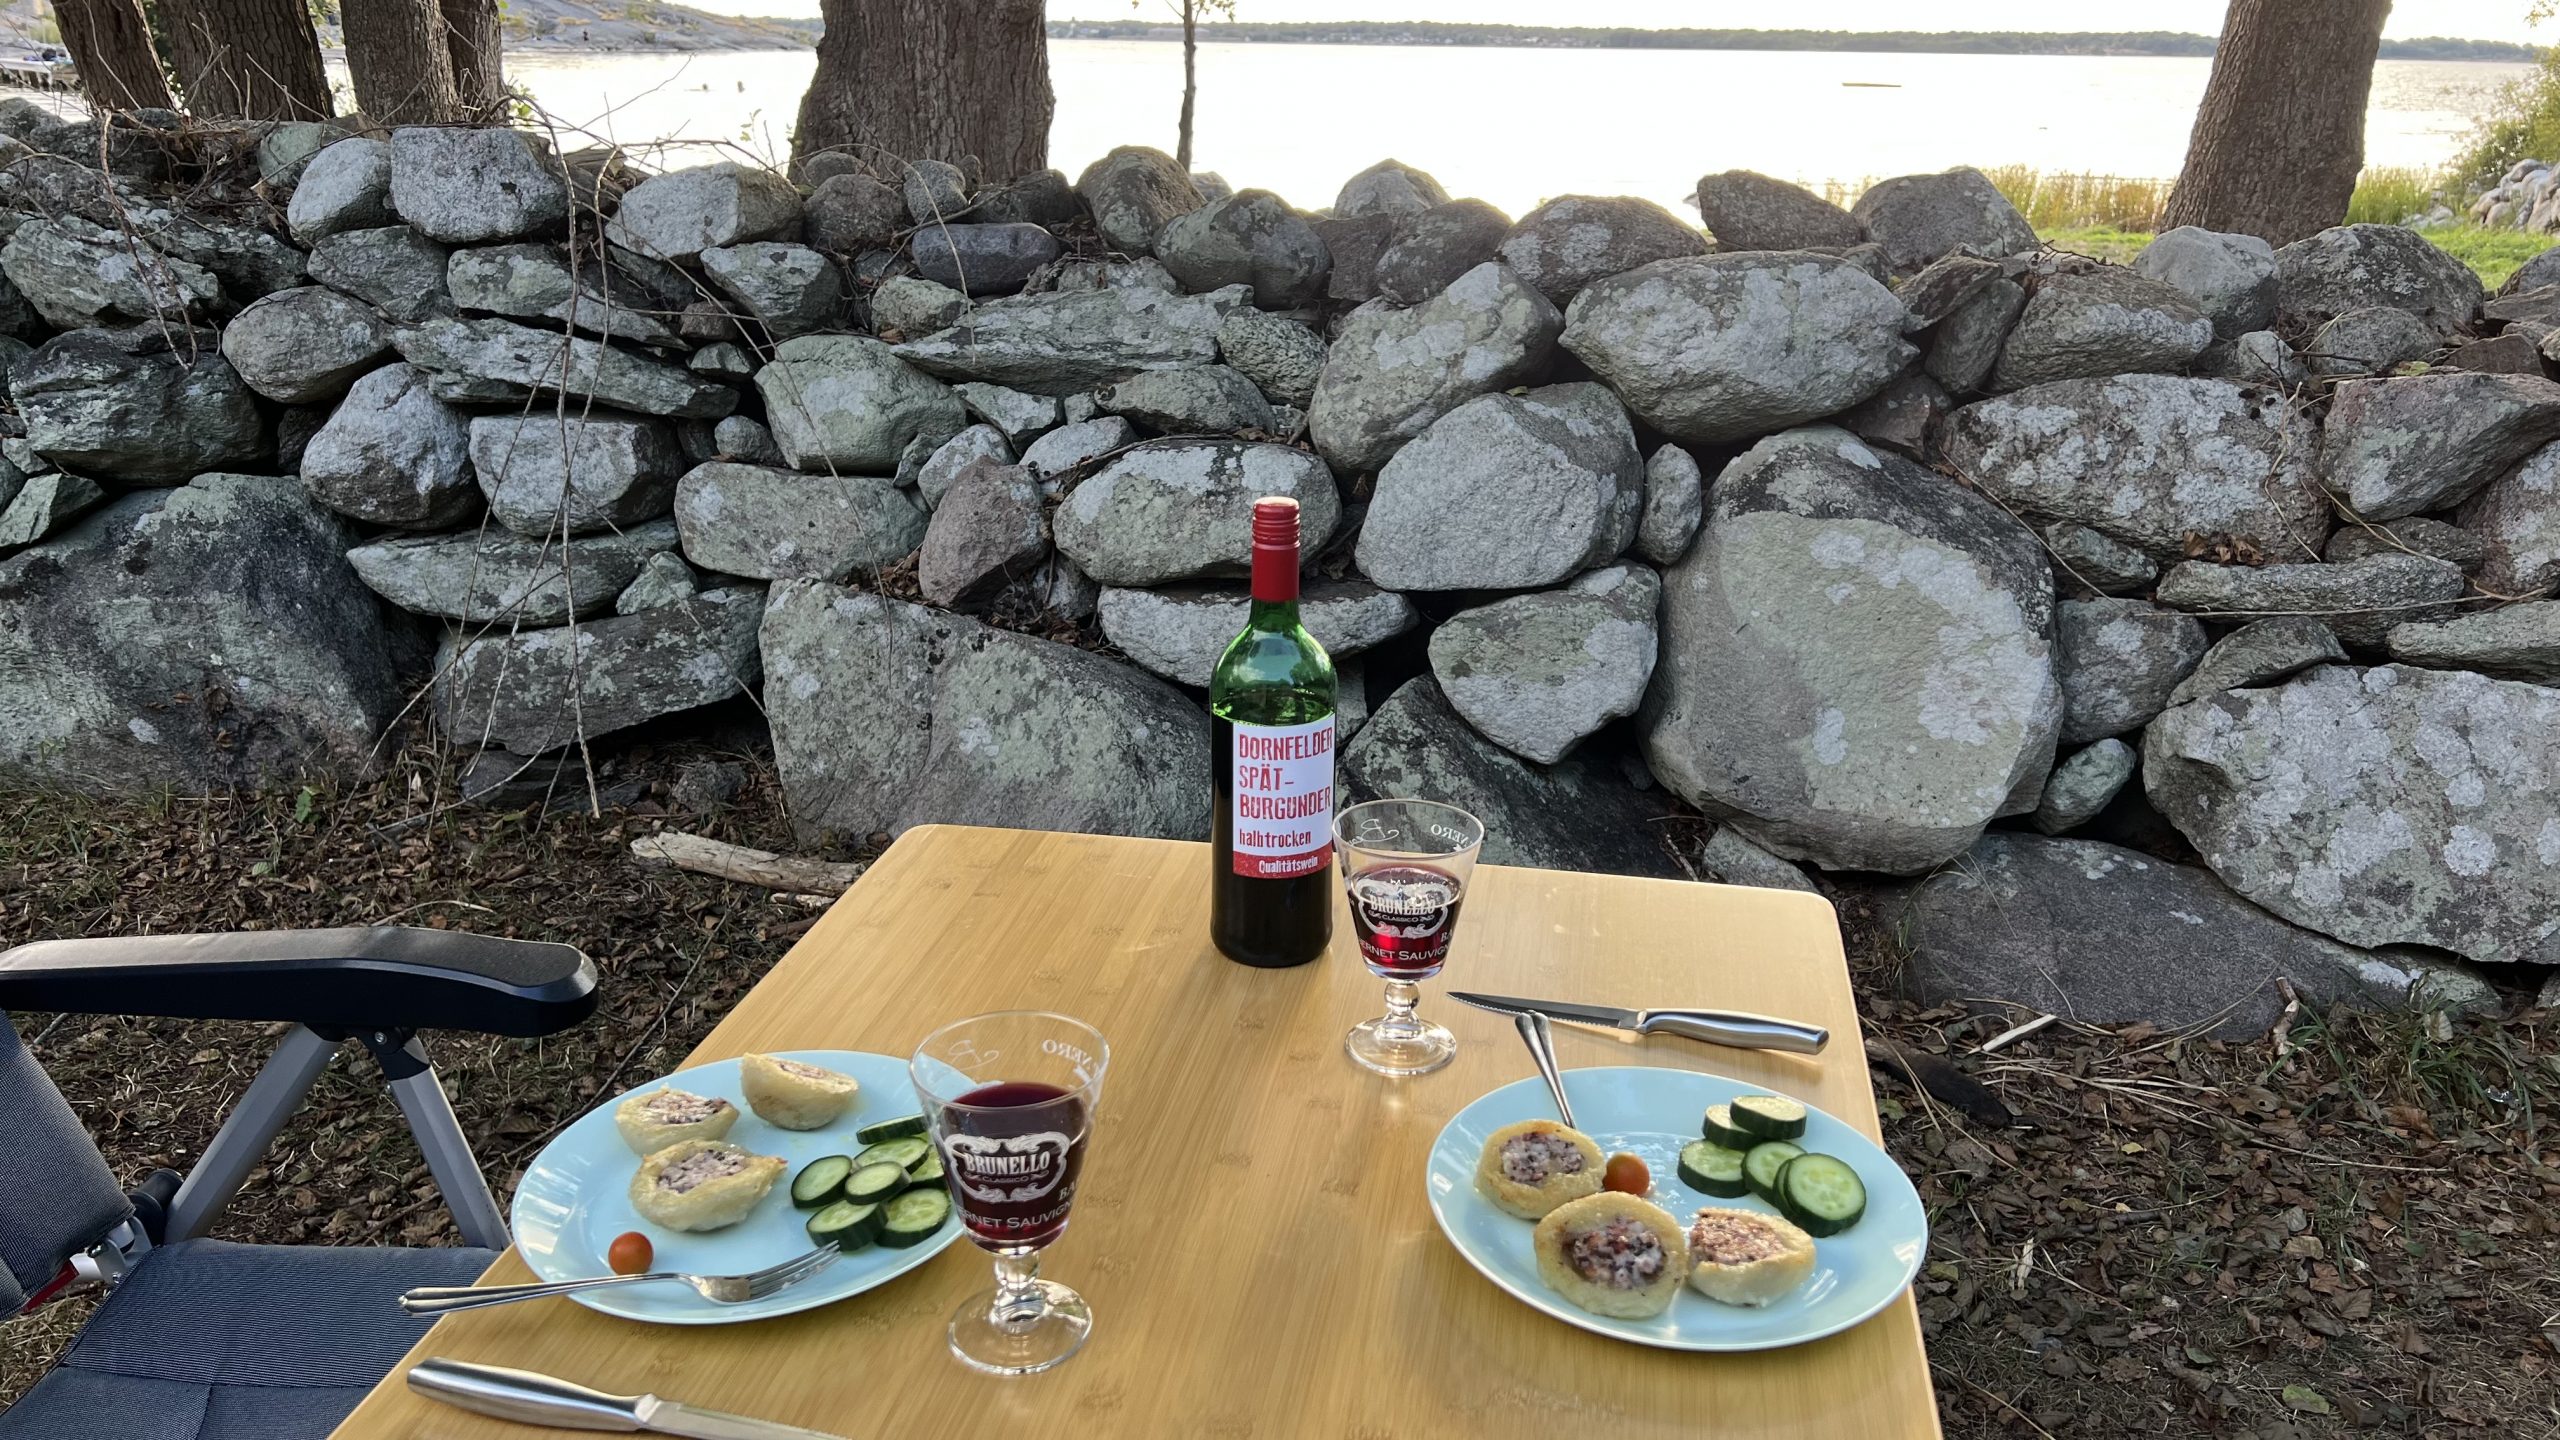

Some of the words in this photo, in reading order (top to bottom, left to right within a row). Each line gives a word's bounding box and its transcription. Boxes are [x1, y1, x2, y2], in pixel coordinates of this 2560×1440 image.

[1239, 726, 1333, 761] DORNFELDER
[1239, 786, 1331, 820] BURGUNDER
[1239, 829, 1311, 848] halbtrocken
[1258, 855, 1318, 874] Qualitätswein
[1369, 894, 1436, 916] BRUNELLO
[1381, 914, 1419, 923] CLASSICO
[963, 1150, 1051, 1175] BRUNELLO
